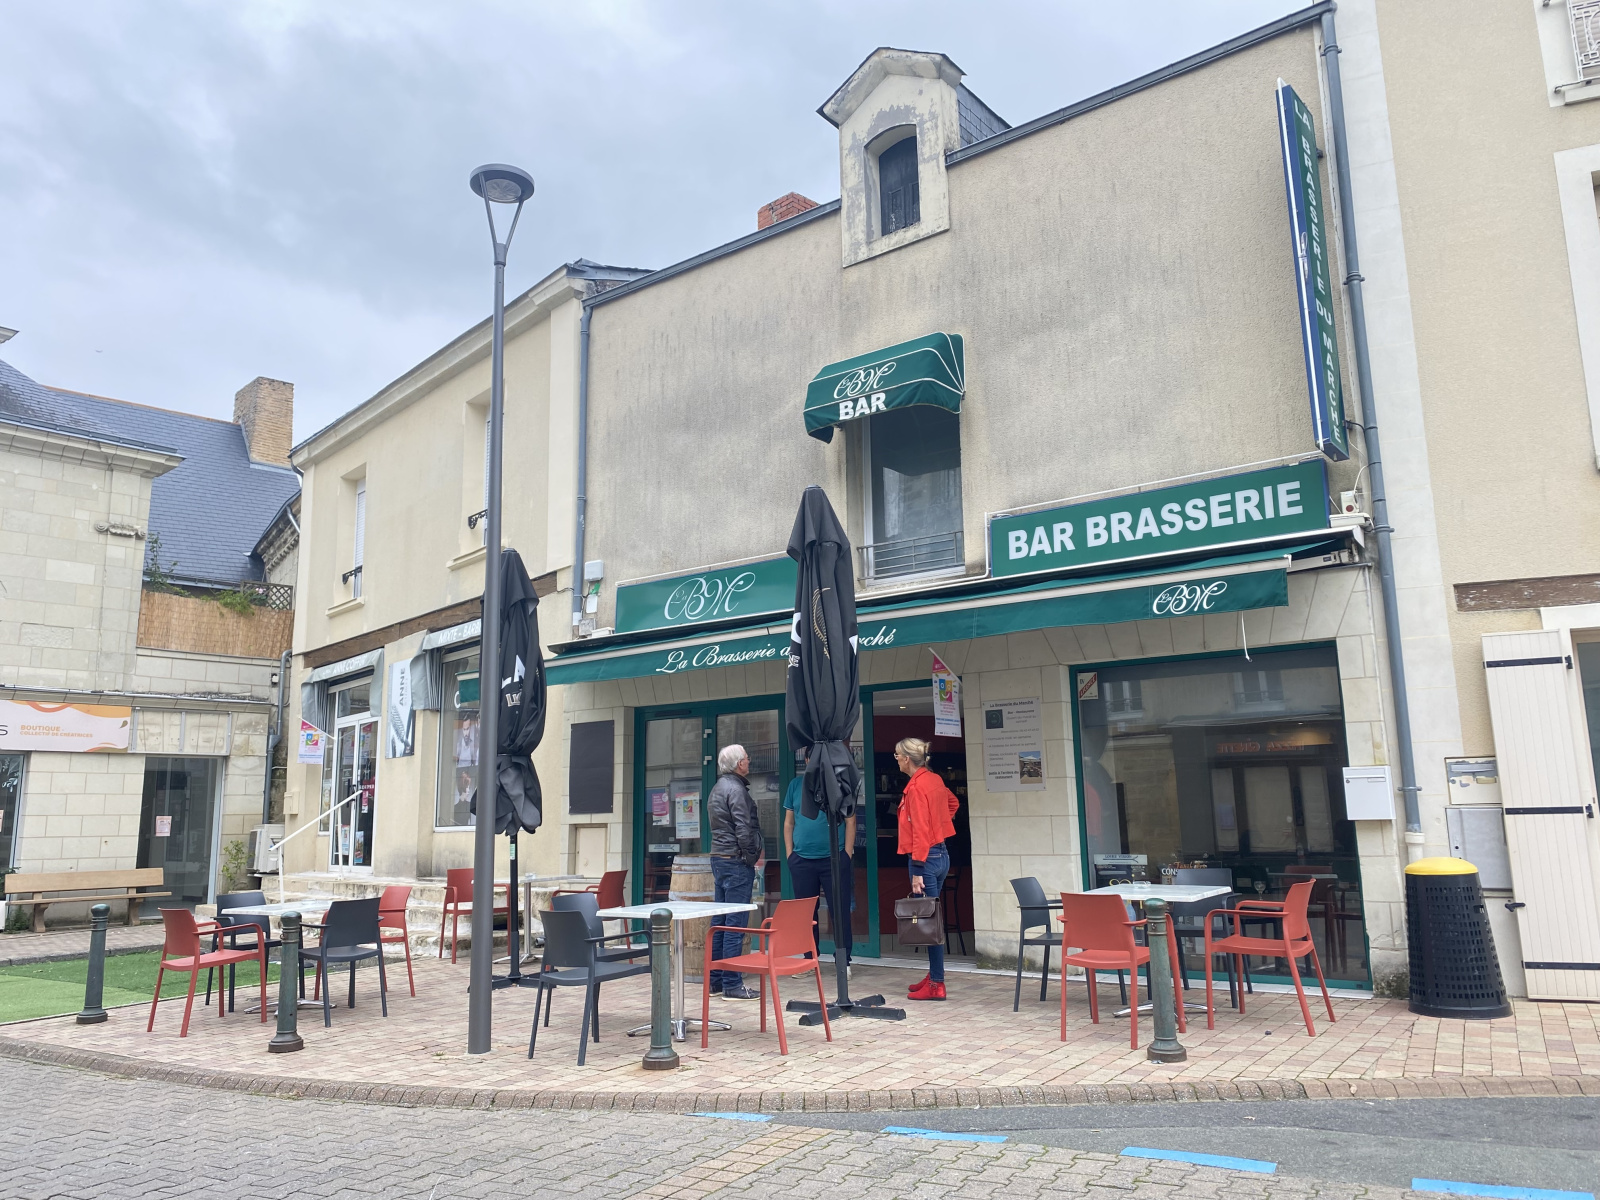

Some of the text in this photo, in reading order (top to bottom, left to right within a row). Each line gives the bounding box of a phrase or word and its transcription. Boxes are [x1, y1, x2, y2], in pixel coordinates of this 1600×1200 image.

[1294, 99, 1311, 132] LA
[1301, 135, 1326, 295] BRASSERIE
[1315, 297, 1333, 326] DU
[838, 391, 886, 420] BAR
[1008, 481, 1303, 560] BAR BRASSERIE
[656, 650, 688, 673] La
[692, 643, 776, 667] Brasserie
